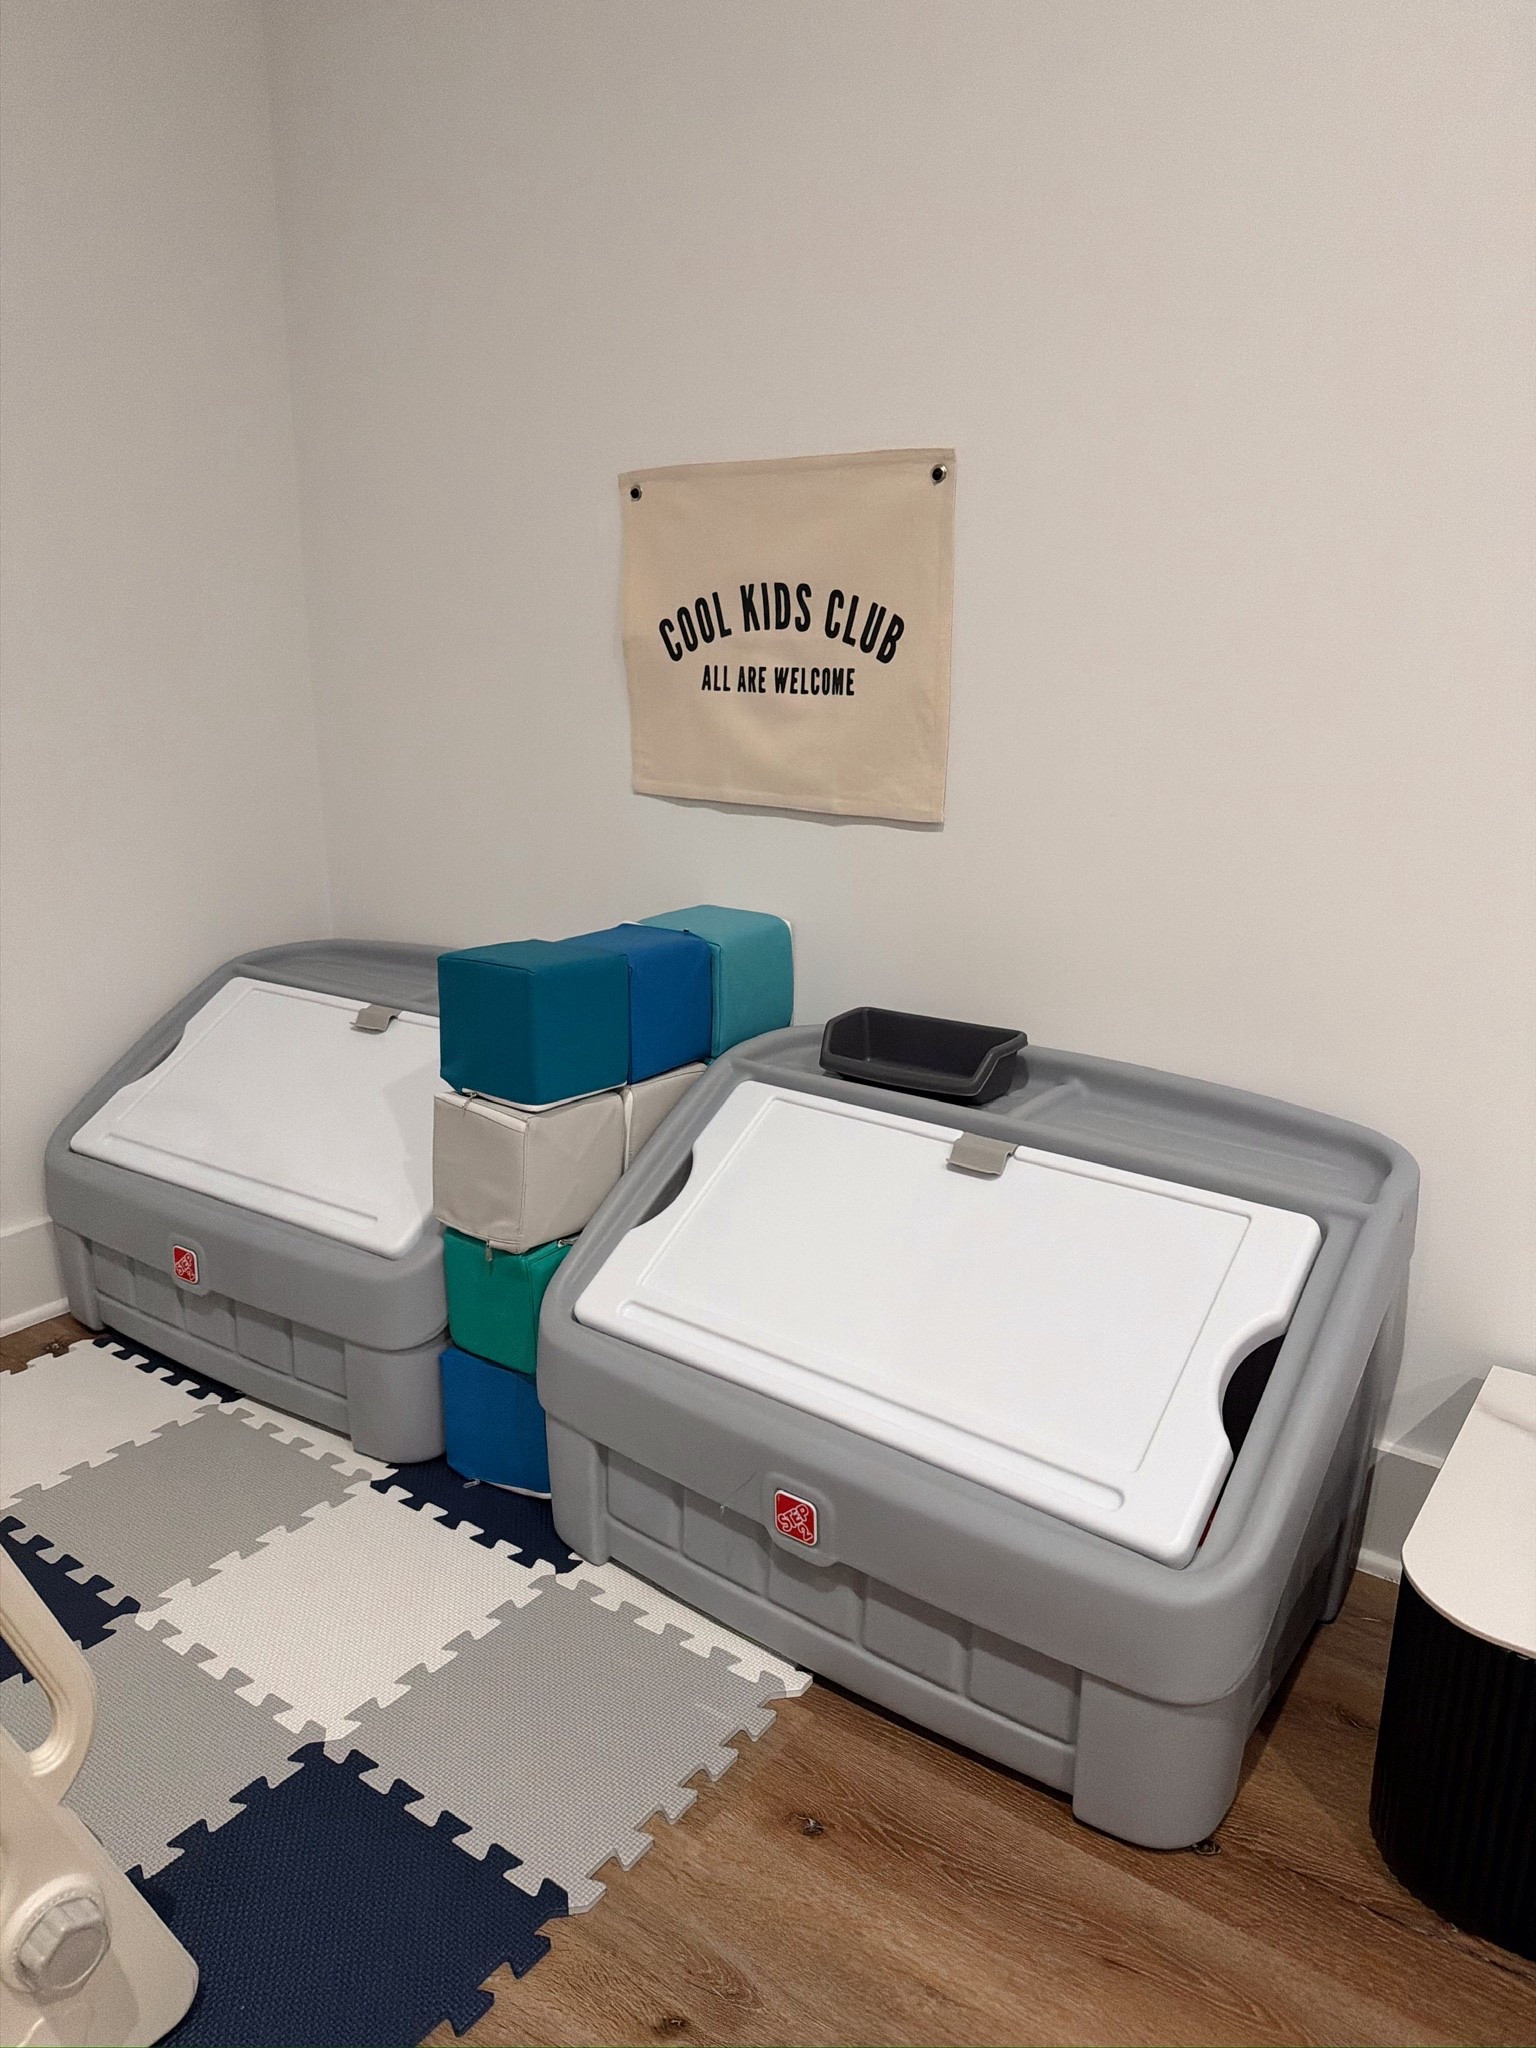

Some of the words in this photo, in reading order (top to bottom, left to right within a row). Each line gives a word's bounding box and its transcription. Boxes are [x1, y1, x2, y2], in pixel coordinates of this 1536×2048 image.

[659, 591, 733, 662] COOL
[740, 582, 812, 633] KIDS
[824, 588, 905, 664] CLUB
[701, 664, 731, 692] ALL
[737, 665, 767, 694] ARE
[774, 666, 856, 697] WELCOME
[778, 1504, 809, 1533] STEP
[797, 1523, 813, 1541] 2
